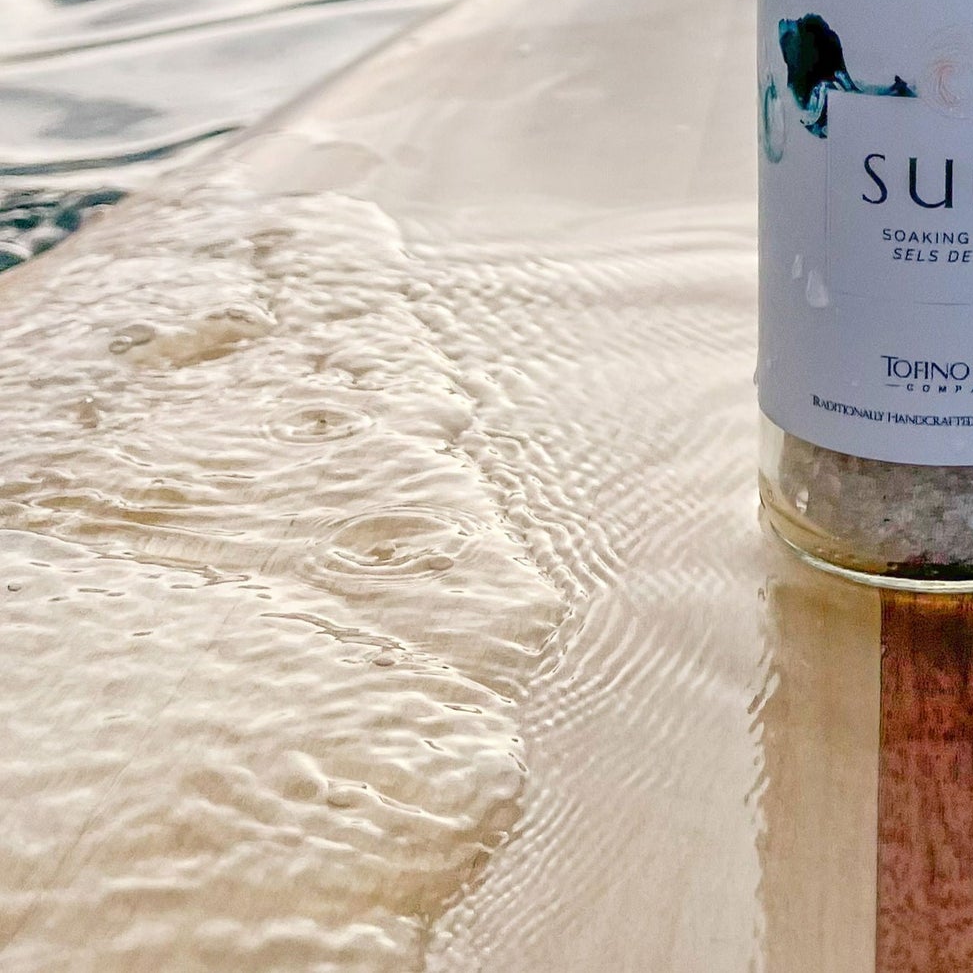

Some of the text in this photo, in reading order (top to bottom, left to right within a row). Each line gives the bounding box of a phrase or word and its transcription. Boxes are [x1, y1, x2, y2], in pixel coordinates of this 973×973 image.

[882, 228, 969, 245] SOAKING
[892, 247, 938, 262] SELS
[948, 248, 972, 263] DE
[880, 355, 970, 380] TOFINO
